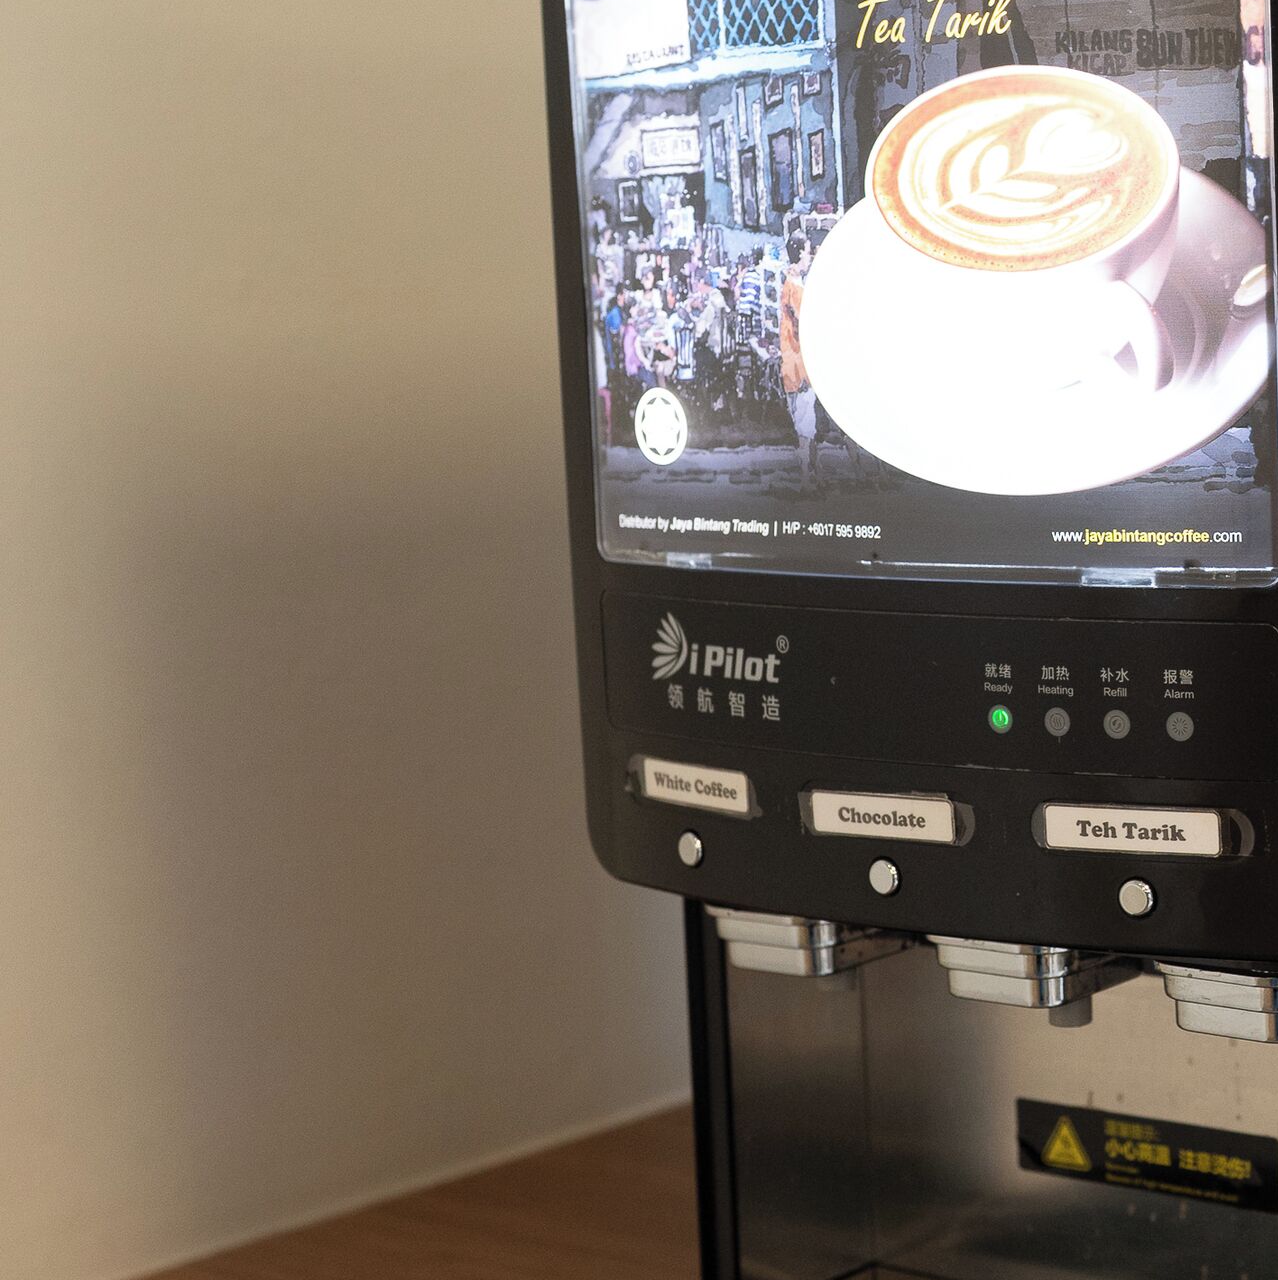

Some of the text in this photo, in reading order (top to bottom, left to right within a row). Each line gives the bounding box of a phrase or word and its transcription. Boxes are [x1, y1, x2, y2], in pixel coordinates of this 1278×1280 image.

[657, 517, 669, 532] by
[670, 517, 693, 533] Jaya
[694, 517, 730, 535] Bintang
[732, 519, 769, 536] Trading
[782, 521, 800, 536] H/P
[808, 524, 833, 537] +6017
[836, 524, 853, 538] 595
[855, 525, 881, 539] 9892
[1051, 528, 1242, 546] www.jayabintangcoffee.com
[984, 662, 1012, 679] 就绪
[1041, 665, 1070, 681] 加热
[1100, 667, 1130, 683] 补水
[1163, 669, 1194, 685] 报警
[984, 682, 1013, 694] Ready
[1037, 684, 1074, 697] Heating
[1103, 687, 1128, 697] Refill
[1164, 689, 1195, 699] Alarm
[666, 683, 781, 721] 领航智造
[653, 771, 738, 800] White Coffee
[837, 806, 926, 828] Chocolate
[1076, 820, 1187, 842] Teh Tarik
